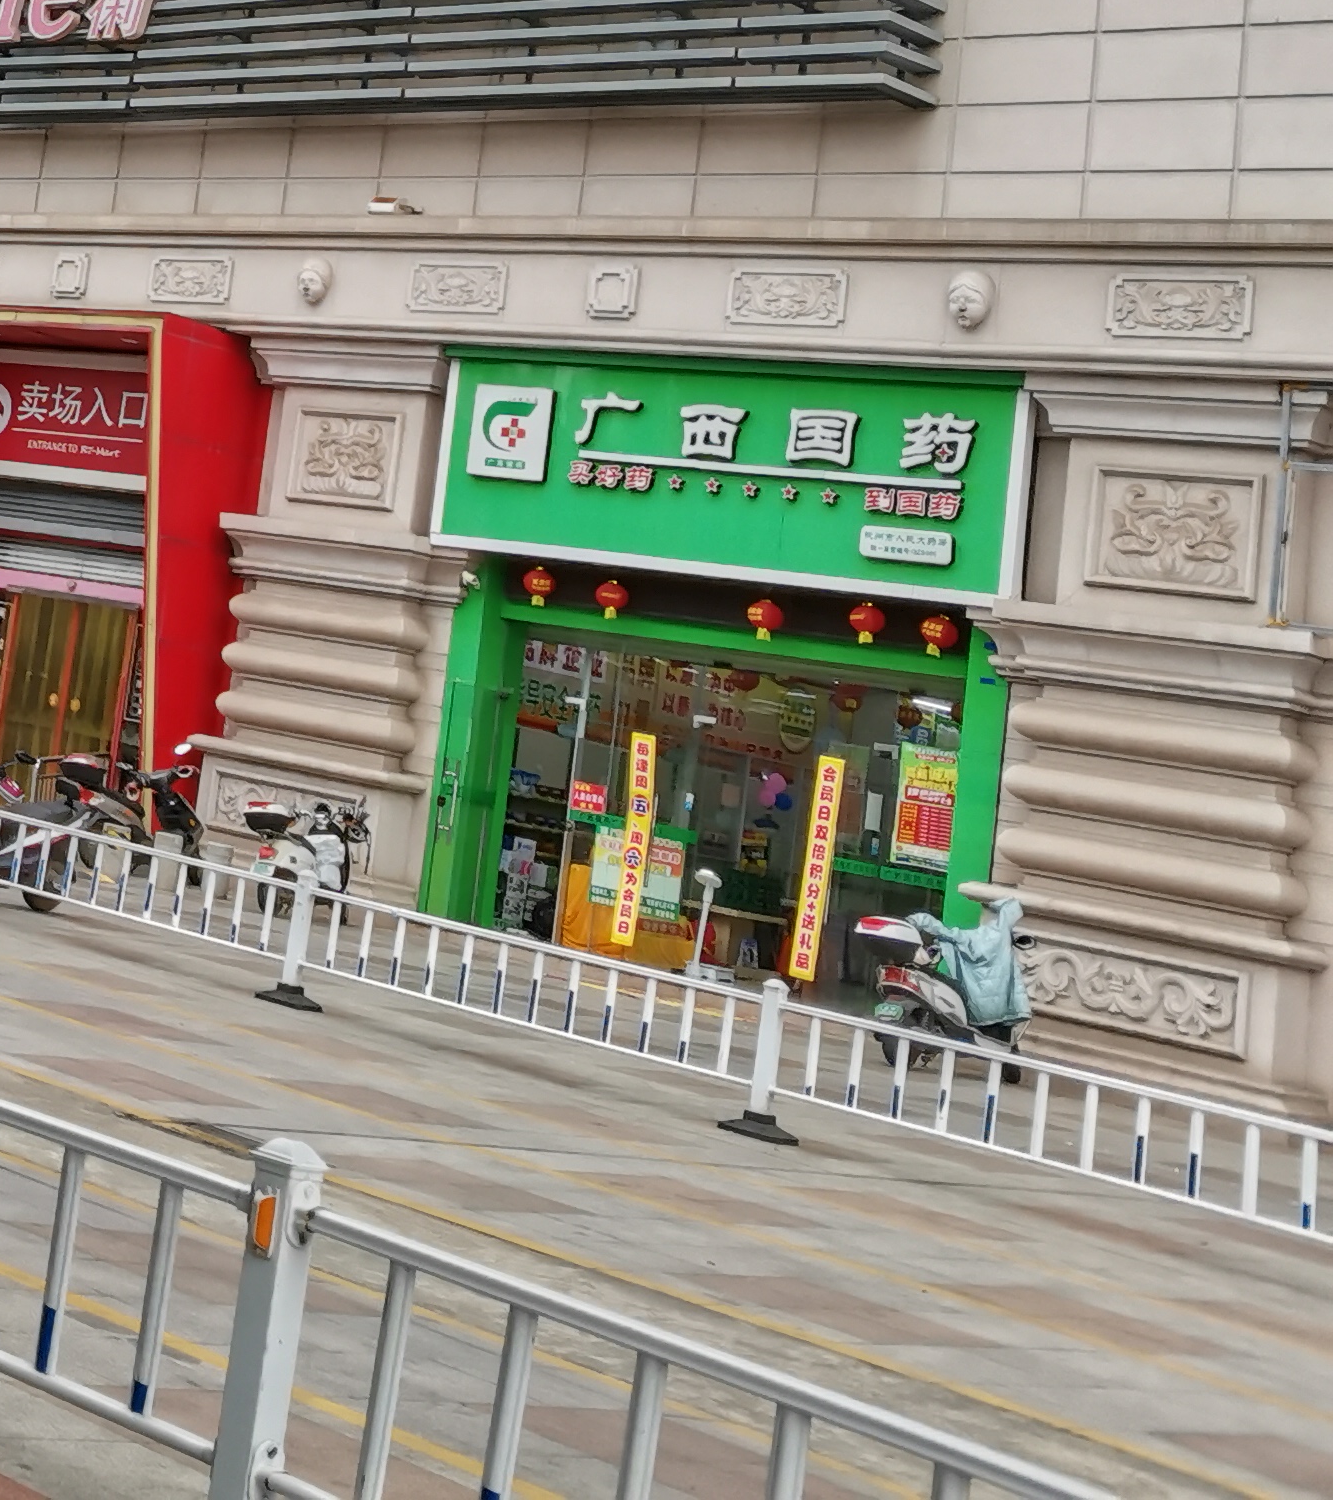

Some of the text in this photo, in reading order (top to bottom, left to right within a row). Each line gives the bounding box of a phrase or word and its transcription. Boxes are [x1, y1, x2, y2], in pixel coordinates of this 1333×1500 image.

[17, 381, 149, 429] 卖场入口
[574, 391, 978, 475] 广西国药
[567, 460, 654, 492] 买好药
[863, 486, 965, 521] 到国药
